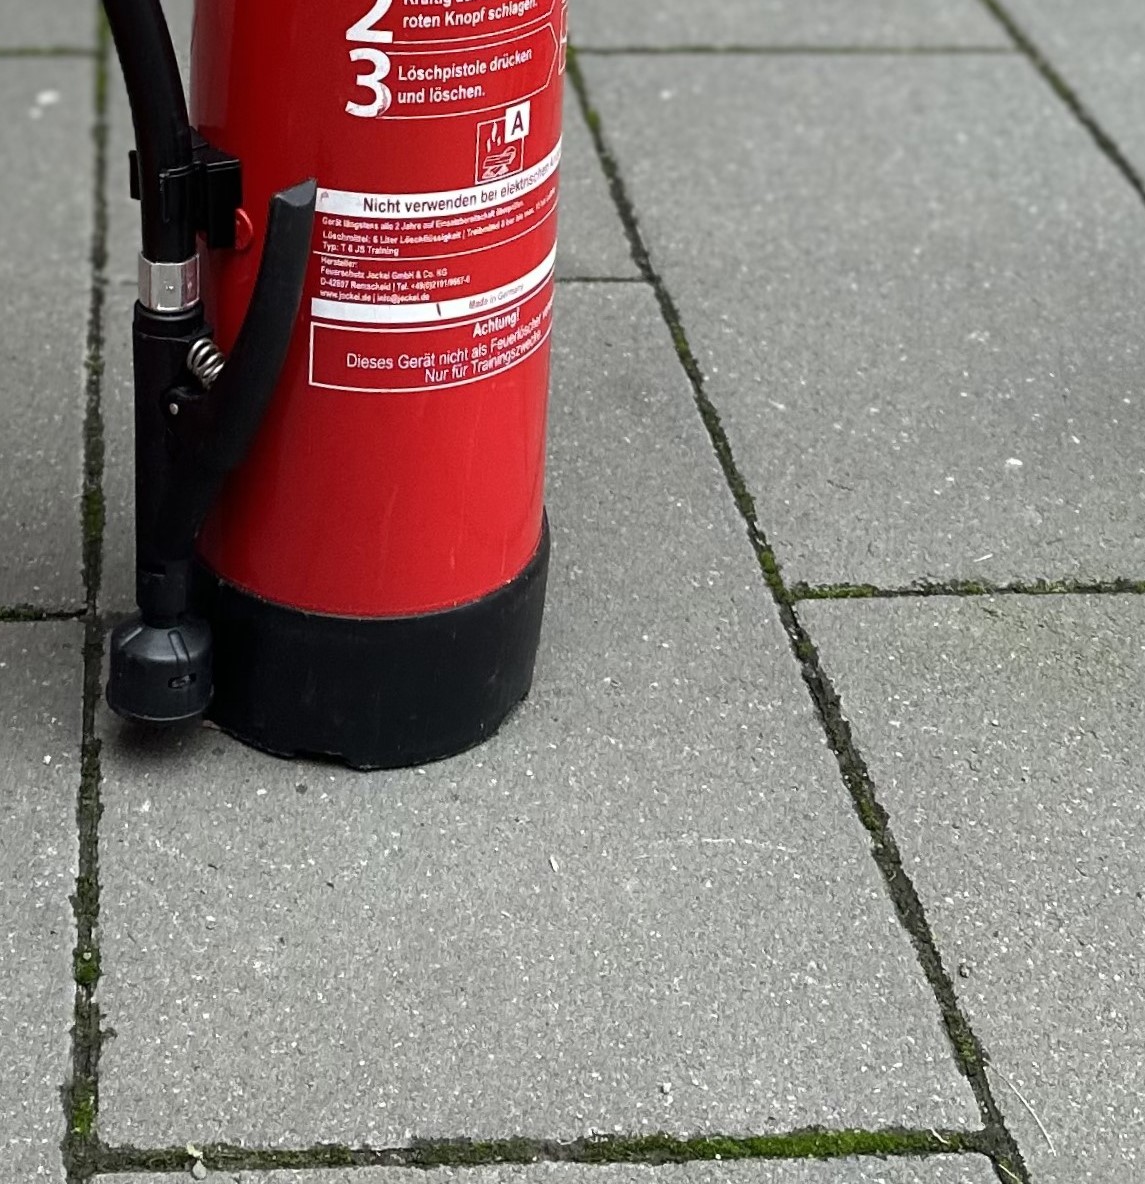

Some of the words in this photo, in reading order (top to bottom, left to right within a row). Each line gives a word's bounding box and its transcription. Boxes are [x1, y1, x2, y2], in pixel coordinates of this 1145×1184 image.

[403, 14, 440, 29] roten
[444, 9, 486, 27] Knopf
[397, 60, 486, 82] Löschpistole
[489, 48, 532, 73] drücken
[345, 47, 392, 118] 3
[397, 88, 424, 104] und
[429, 85, 485, 104] löschen.
[510, 110, 524, 136] A
[363, 197, 401, 214] Nicht
[405, 194, 477, 214] verwenden
[480, 190, 498, 203] bei
[473, 306, 521, 338] Achtung!
[346, 353, 393, 370] Dieses
[397, 352, 435, 369] Gerät
[439, 347, 469, 365] nicht
[472, 343, 488, 359] als
[424, 367, 449, 383] Nur
[452, 364, 468, 380] für
